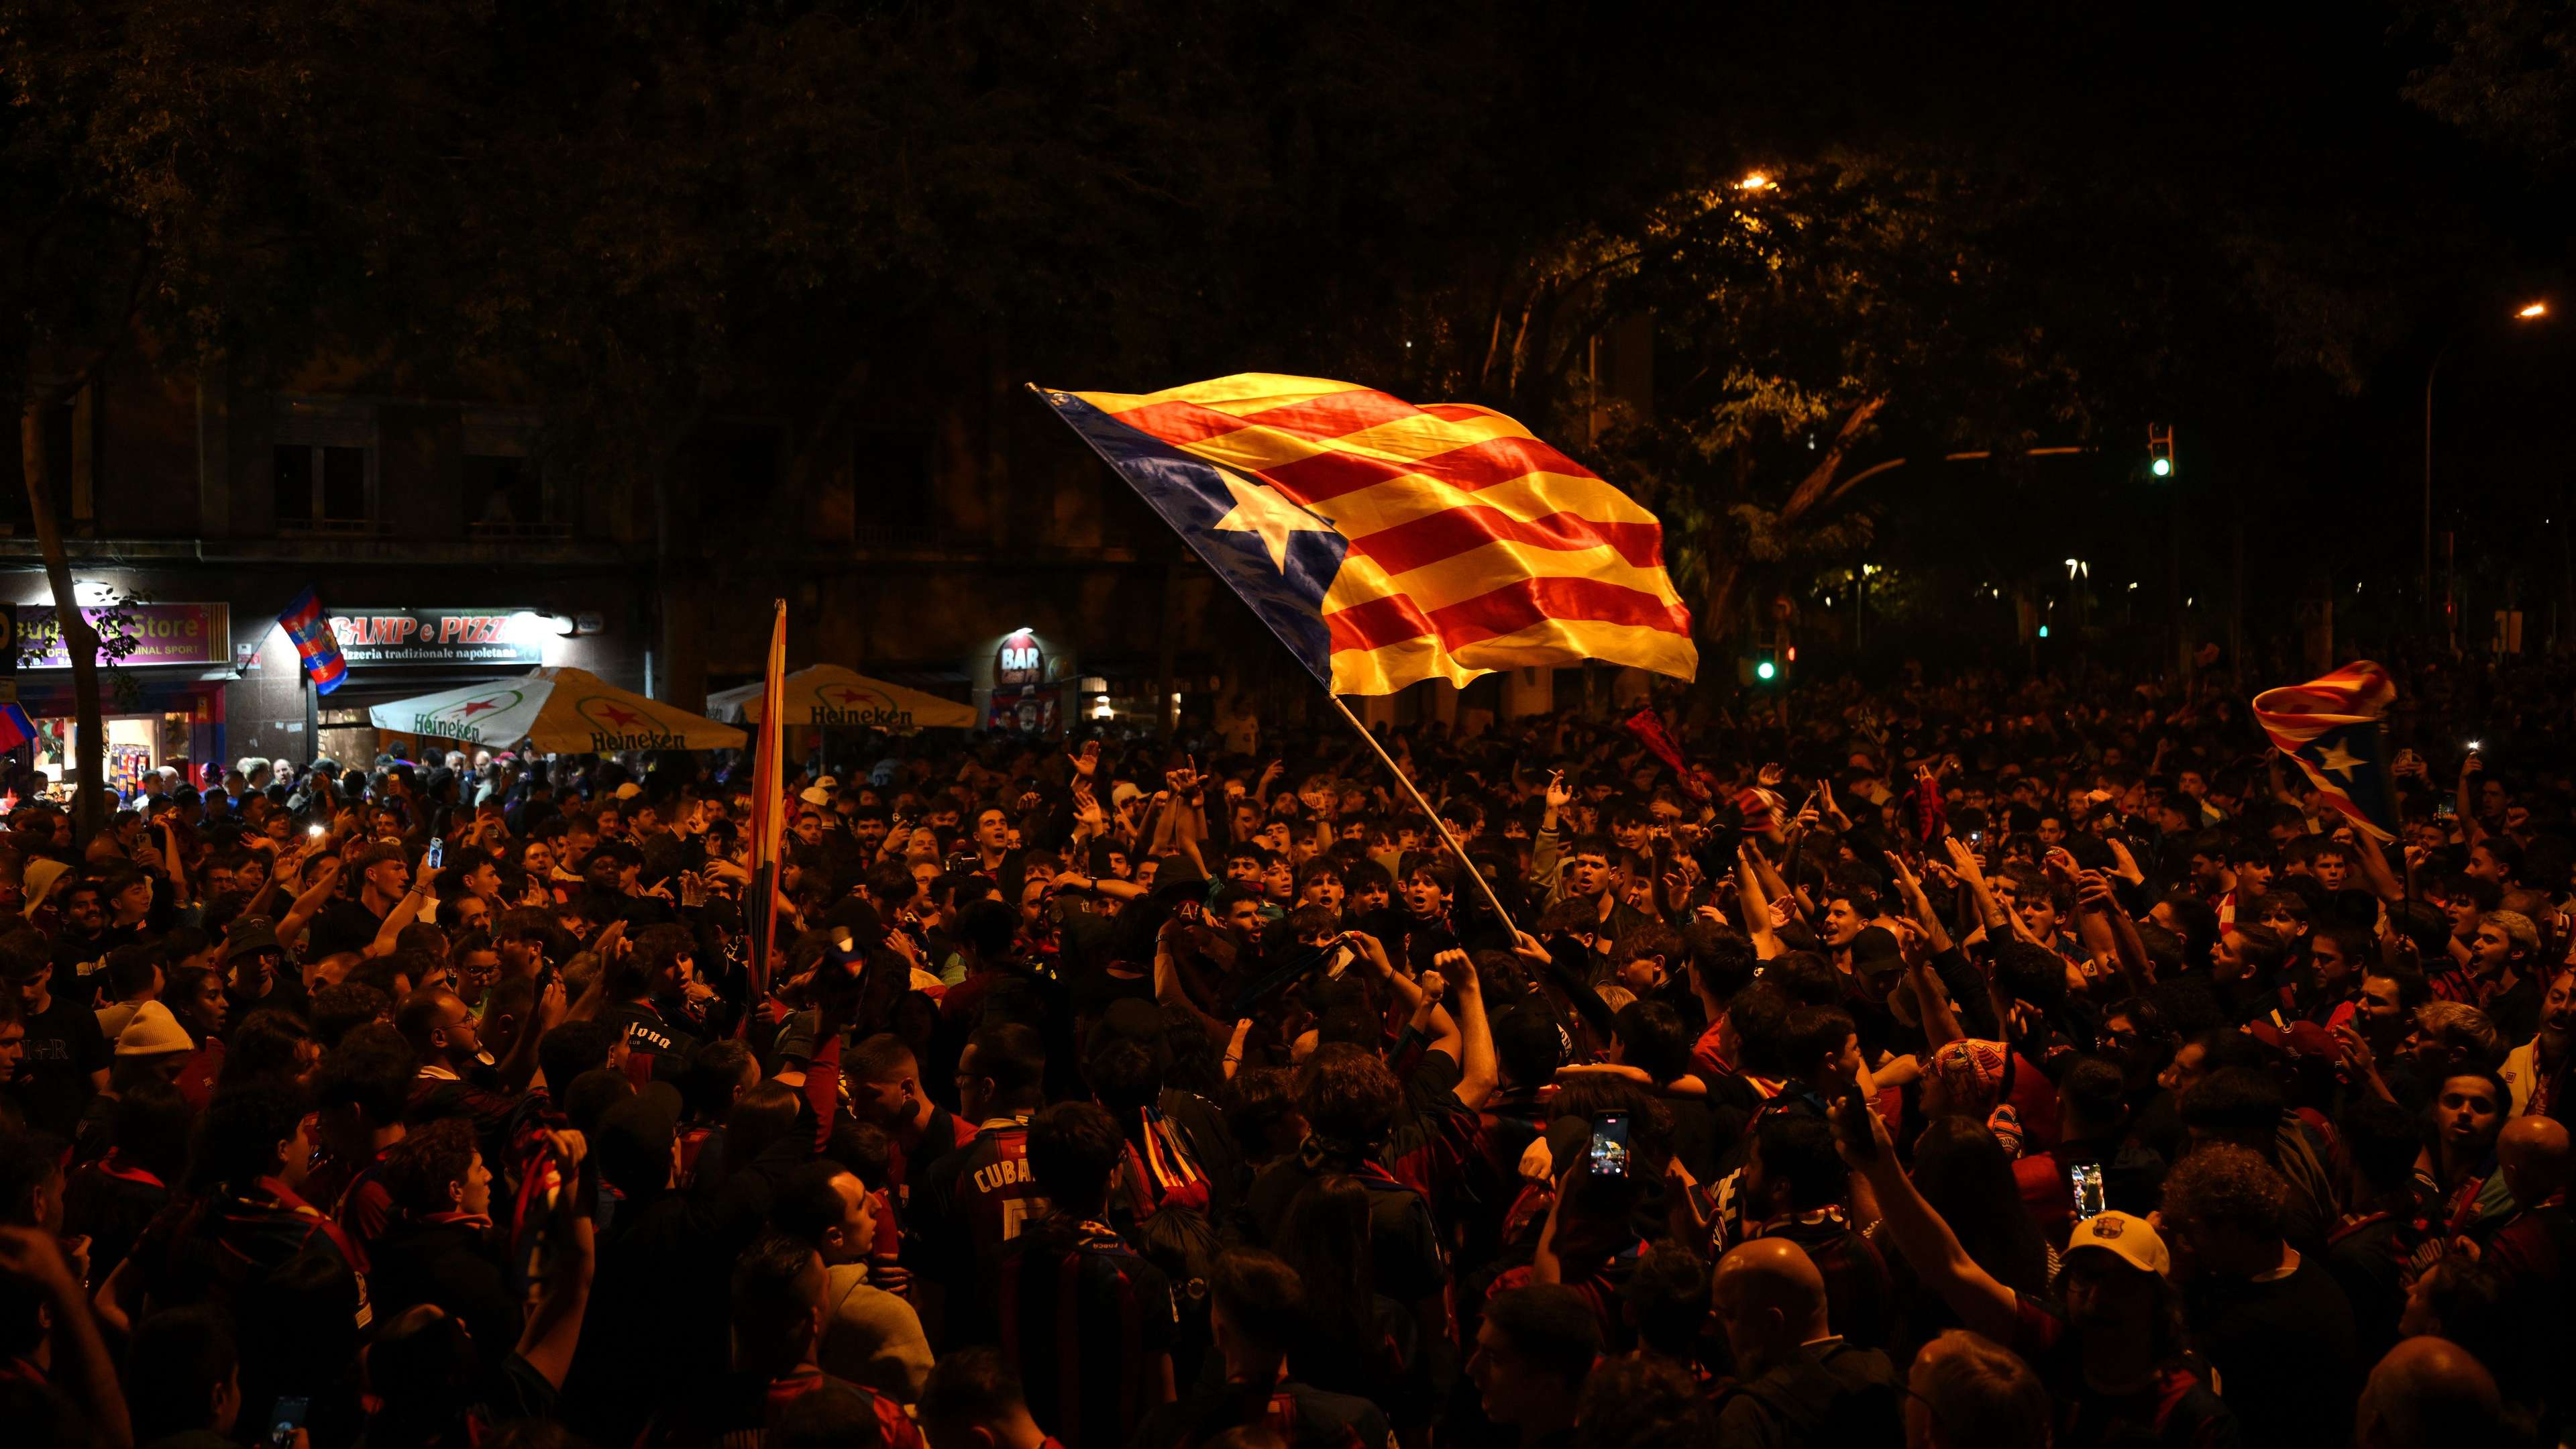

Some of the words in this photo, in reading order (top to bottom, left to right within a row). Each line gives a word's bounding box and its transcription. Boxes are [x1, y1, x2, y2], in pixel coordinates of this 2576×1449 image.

[130, 614, 199, 639] Store
[329, 616, 418, 645] CAMP
[420, 623, 435, 641] e
[165, 645, 199, 655] SPORT
[341, 648, 382, 660] izzeria
[385, 647, 453, 659] tradizionale
[455, 647, 517, 661] napoletana
[1001, 647, 1040, 669] BAR
[810, 706, 914, 726] Heineken
[413, 712, 481, 743] Heineken
[590, 730, 686, 751] Heineken
[973, 1158, 1036, 1193] CUBA
